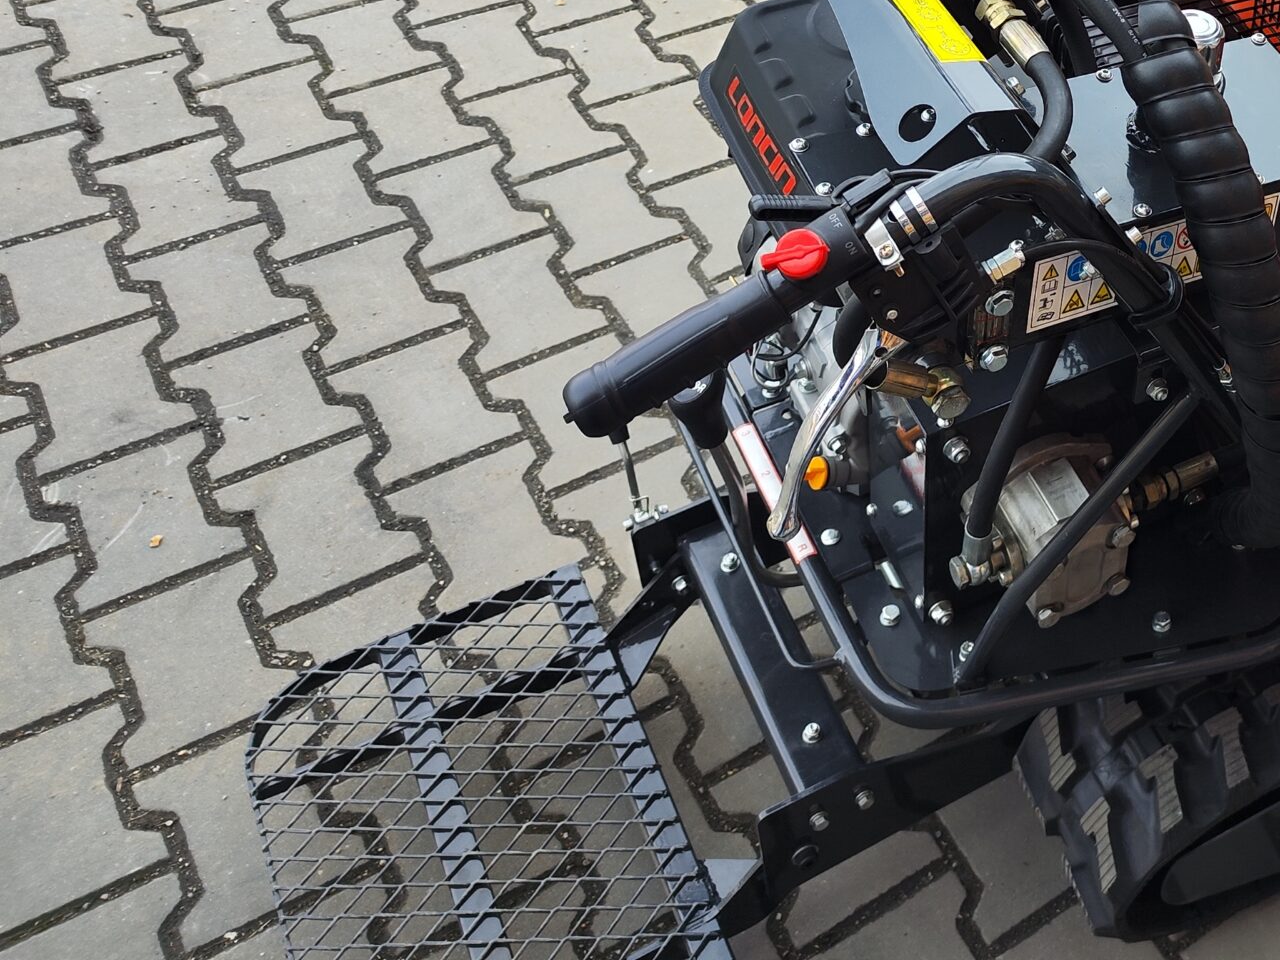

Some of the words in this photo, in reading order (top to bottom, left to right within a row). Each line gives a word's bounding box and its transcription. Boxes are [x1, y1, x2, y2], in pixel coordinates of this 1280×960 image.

[828, 213, 843, 229] OFF
[845, 241, 858, 255] ON
[797, 543, 808, 553] R
